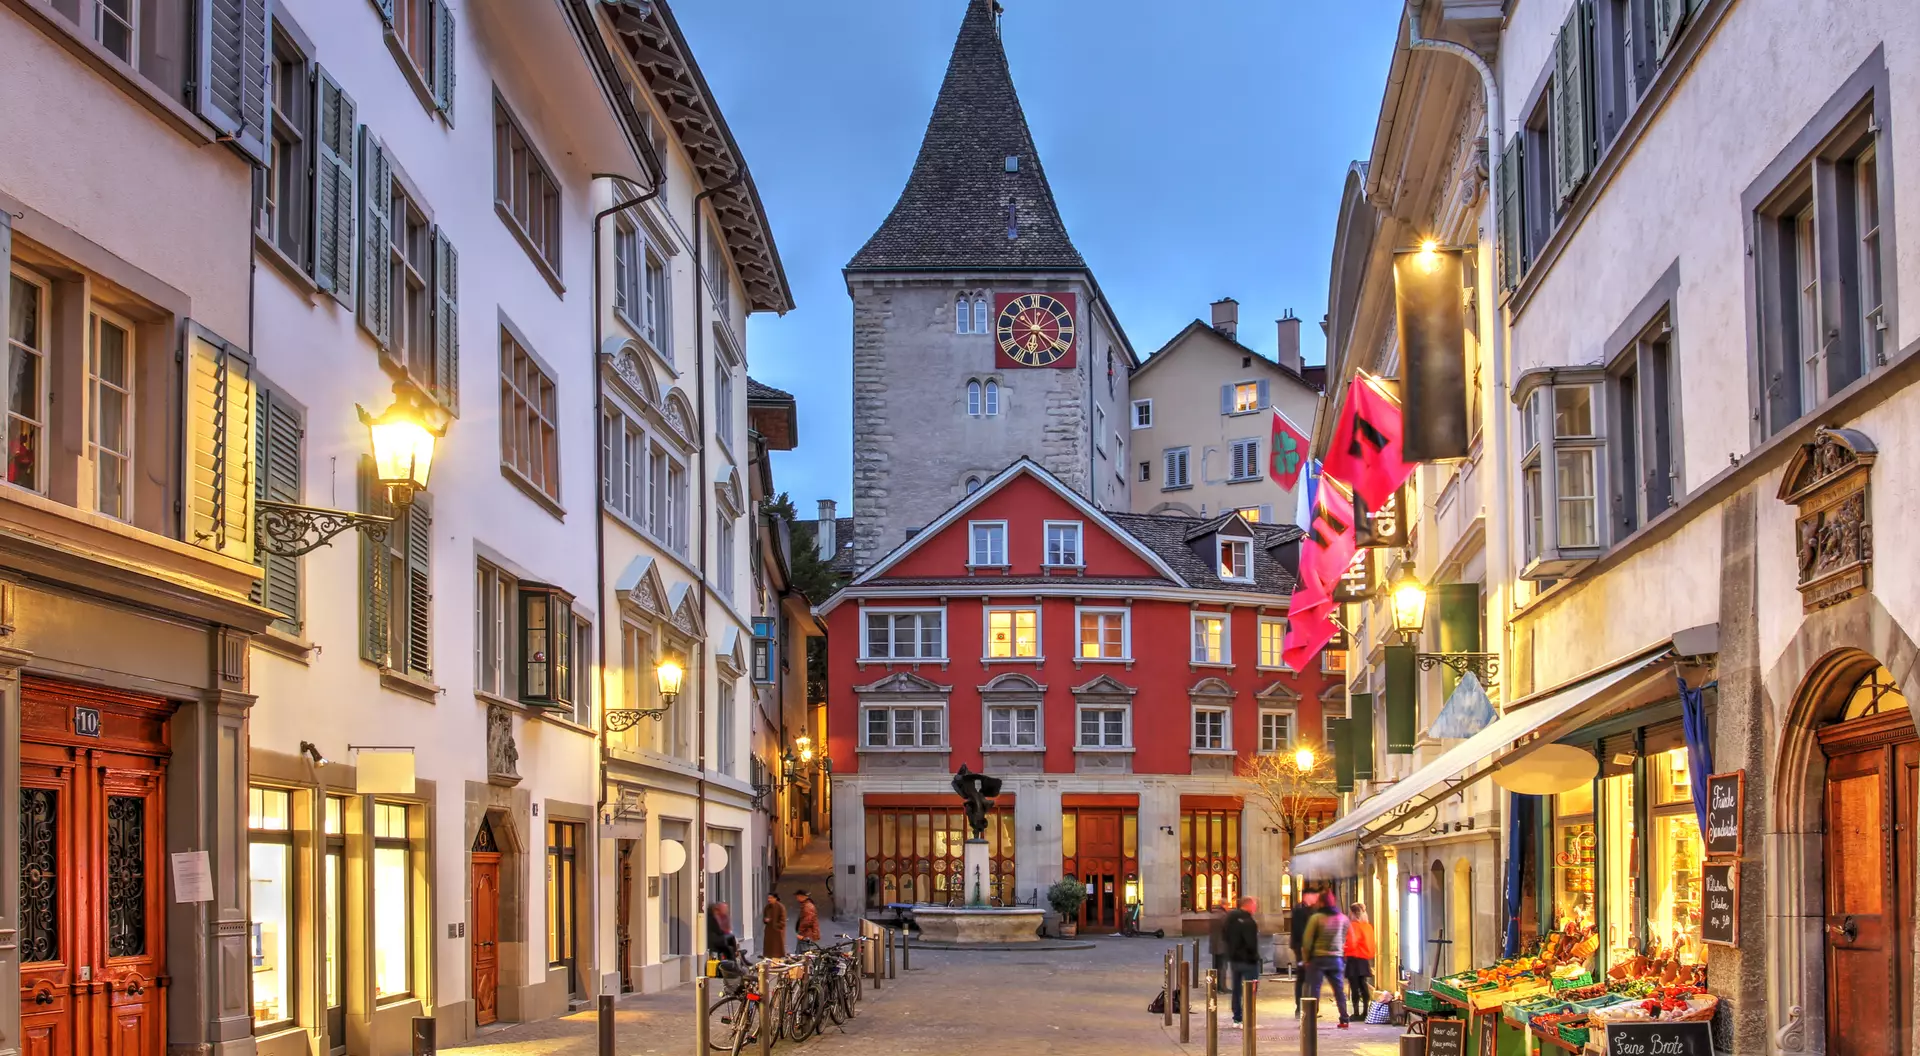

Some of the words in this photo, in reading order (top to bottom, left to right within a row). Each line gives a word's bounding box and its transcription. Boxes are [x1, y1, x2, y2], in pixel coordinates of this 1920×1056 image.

[80, 711, 97, 733] 10
[1712, 784, 1736, 810] Frische
[1614, 1031, 1645, 1055] Feine
[1650, 1033, 1684, 1055] Brote
